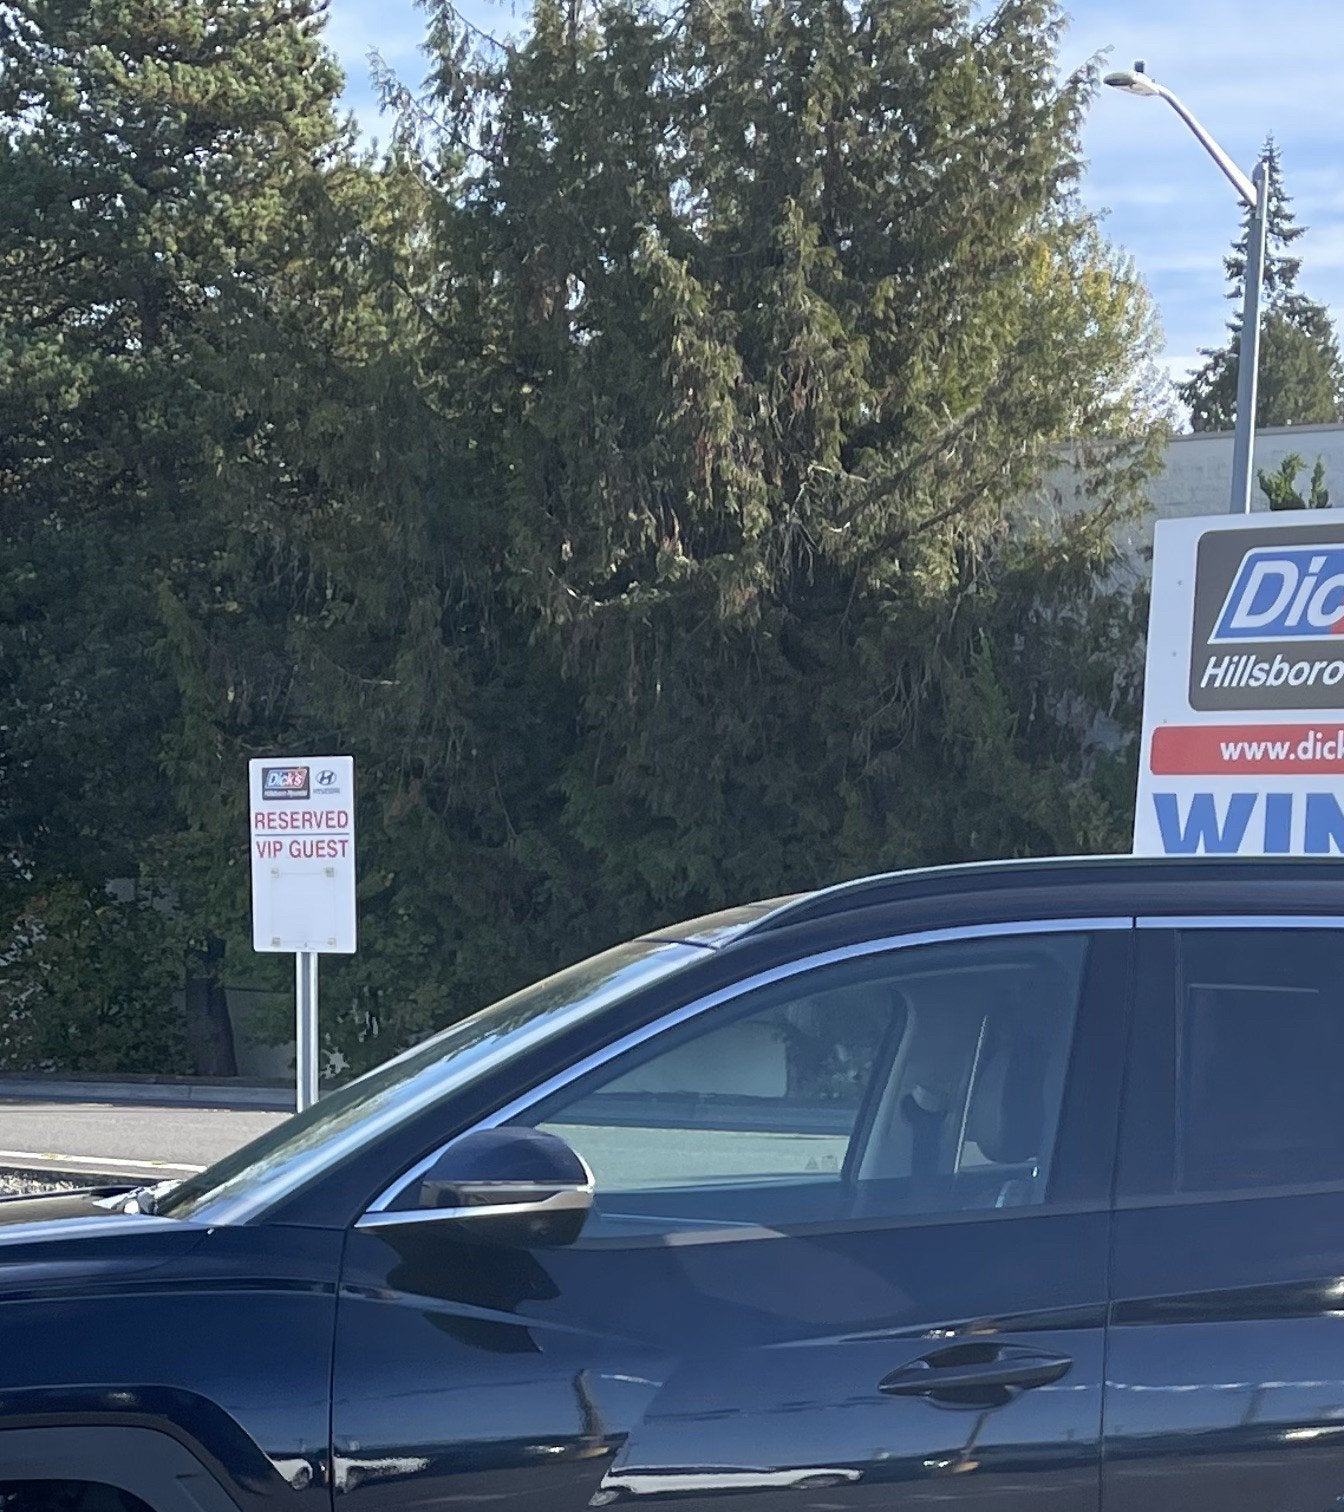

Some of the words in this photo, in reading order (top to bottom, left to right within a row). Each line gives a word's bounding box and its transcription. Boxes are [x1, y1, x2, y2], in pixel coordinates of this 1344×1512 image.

[254, 810, 349, 829] RESERVED
[256, 840, 283, 858] VIP
[289, 839, 349, 858] GUEST
